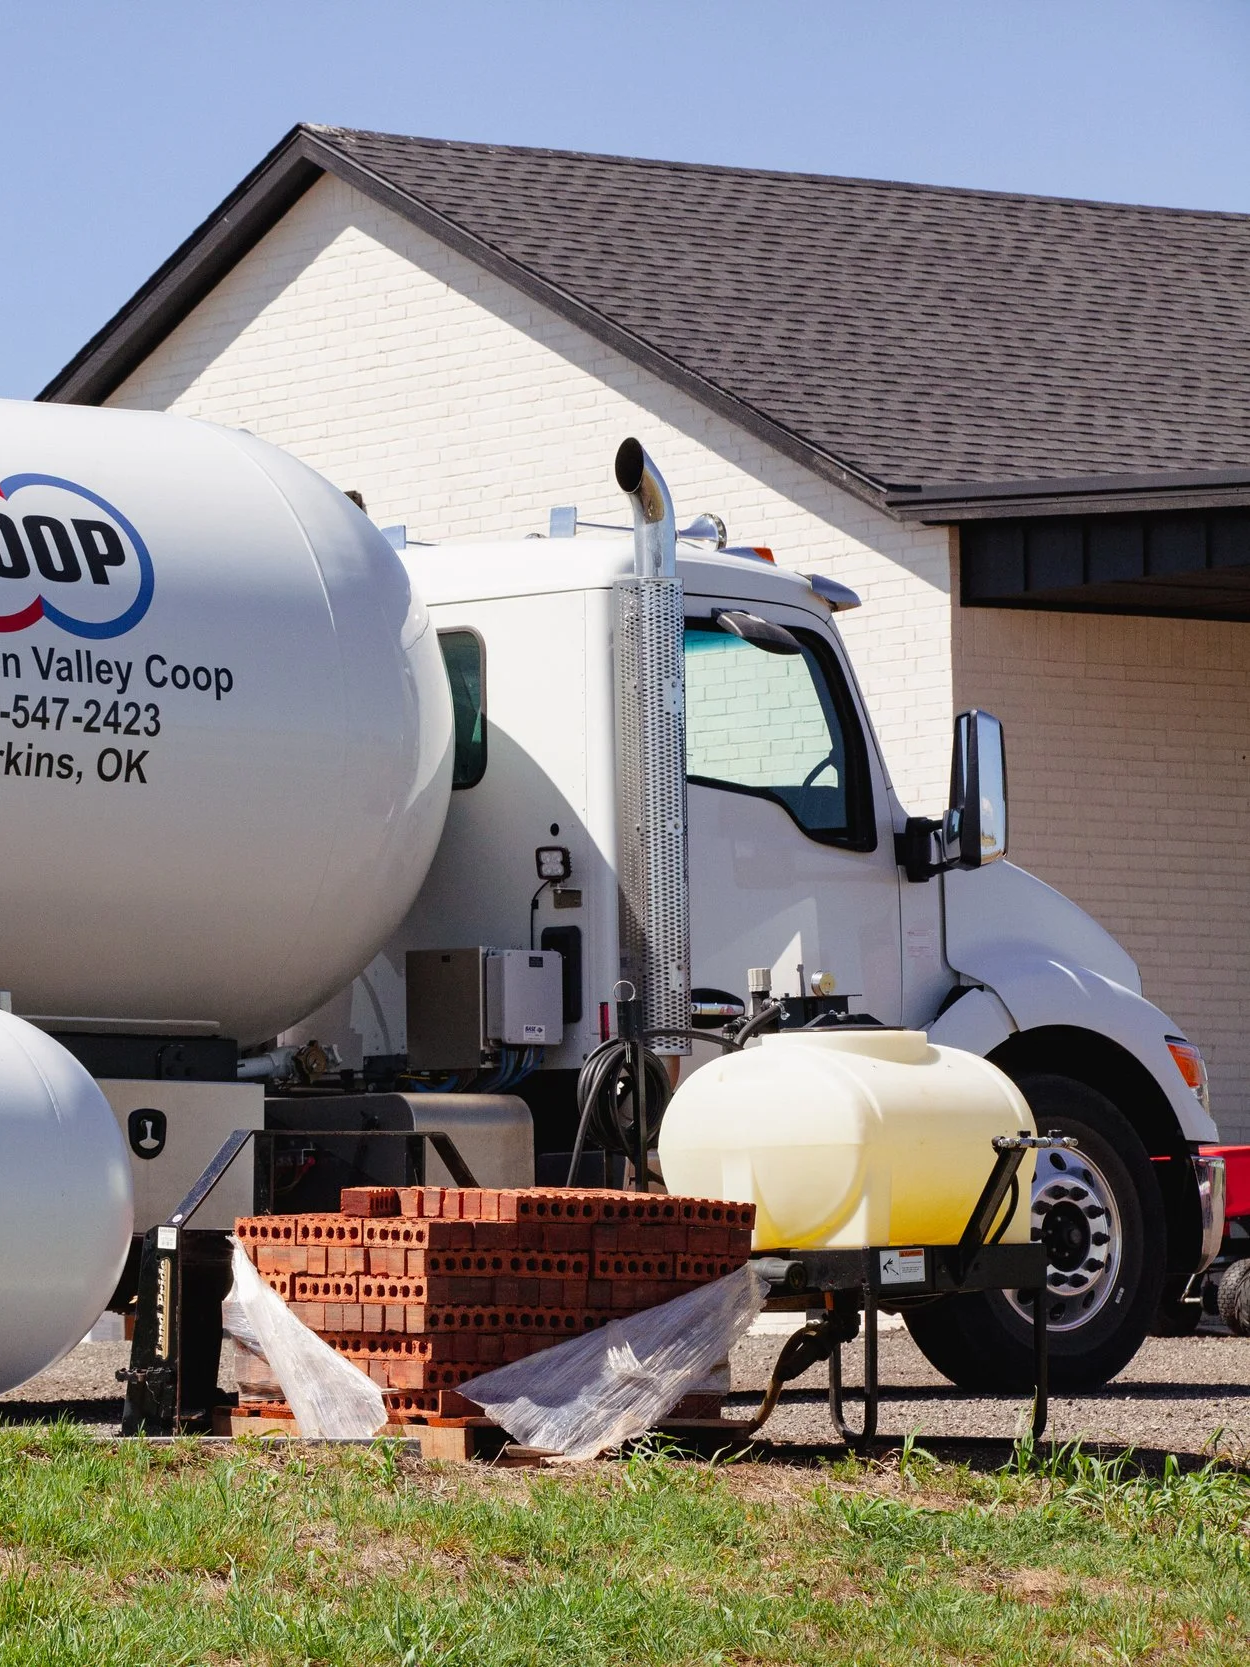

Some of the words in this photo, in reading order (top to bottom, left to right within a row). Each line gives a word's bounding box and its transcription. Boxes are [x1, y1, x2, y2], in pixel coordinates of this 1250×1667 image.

[30, 646, 133, 694] Valley
[145, 654, 234, 700] Coop
[97, 747, 150, 784] OK
